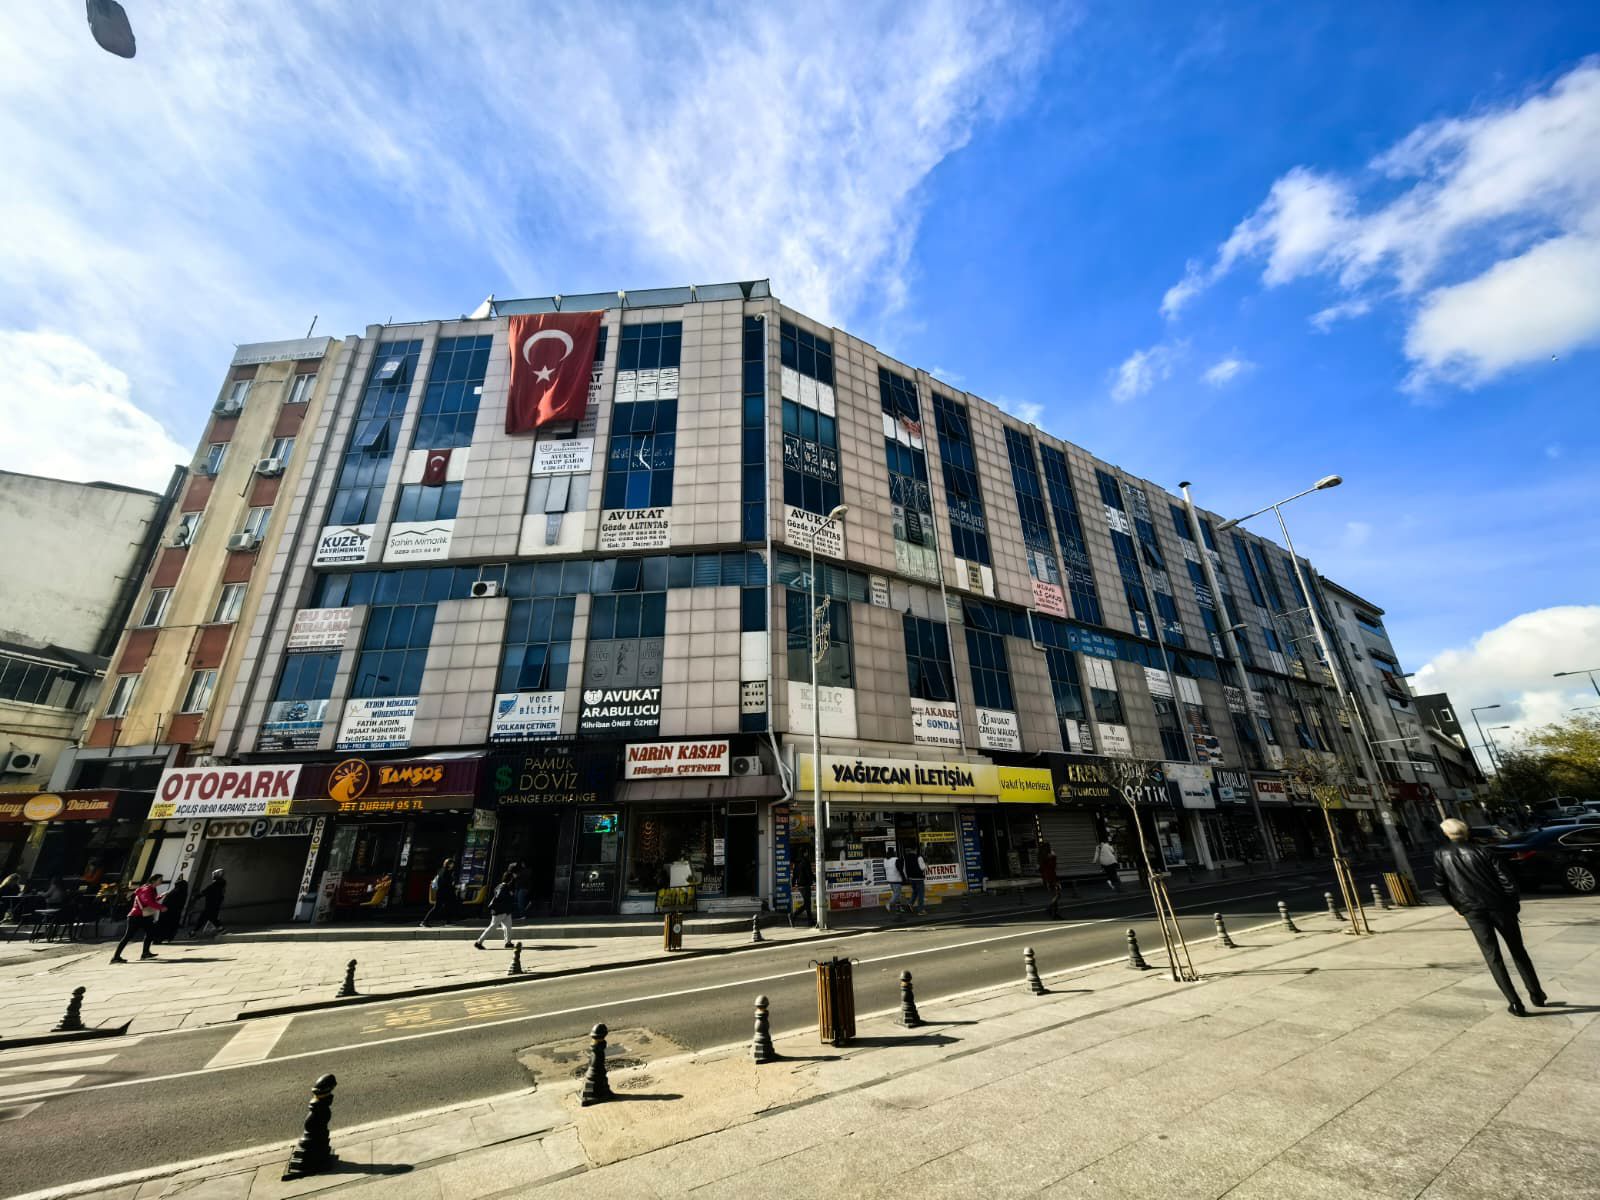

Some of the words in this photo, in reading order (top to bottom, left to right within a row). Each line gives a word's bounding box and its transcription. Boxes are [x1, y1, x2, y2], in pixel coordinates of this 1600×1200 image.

[608, 509, 664, 520] AVUKAT
[791, 509, 836, 530] AVUKAT
[602, 523, 626, 531] Gözde
[322, 535, 366, 548] KUZEY
[530, 695, 553, 704] VOCE
[603, 688, 660, 701] AVUKAT
[801, 688, 843, 706] KLIÇ
[519, 704, 560, 715] BİLİŞİM
[582, 705, 659, 718] ARABULUCU
[925, 706, 959, 719] AKARSU
[496, 723, 524, 732] VOLKAN
[526, 721, 556, 732] ÇETİNER
[611, 718, 631, 728] ÖNER
[627, 745, 674, 762] NARİN
[677, 744, 727, 760] KASAP
[524, 757, 574, 770] PAMUK
[632, 765, 674, 776] Hüseyin
[677, 763, 721, 775] ÇETİNER
[519, 770, 578, 791] DÖVİZ
[832, 760, 912, 785] YAĞIZCAN
[914, 763, 975, 792] İLETİŞİM
[161, 770, 296, 802] OTOPARK
[498, 794, 542, 805] CHANGE
[543, 792, 599, 803] EXCHANGE
[1125, 785, 1168, 802] OPTİK
[175, 804, 199, 816] AÇILIŞ
[199, 803, 218, 814] 08:00
[218, 803, 248, 815] KAPANIŞ
[247, 802, 266, 812] 22:00
[186, 822, 202, 853] OTO
[312, 819, 325, 843] OTO
